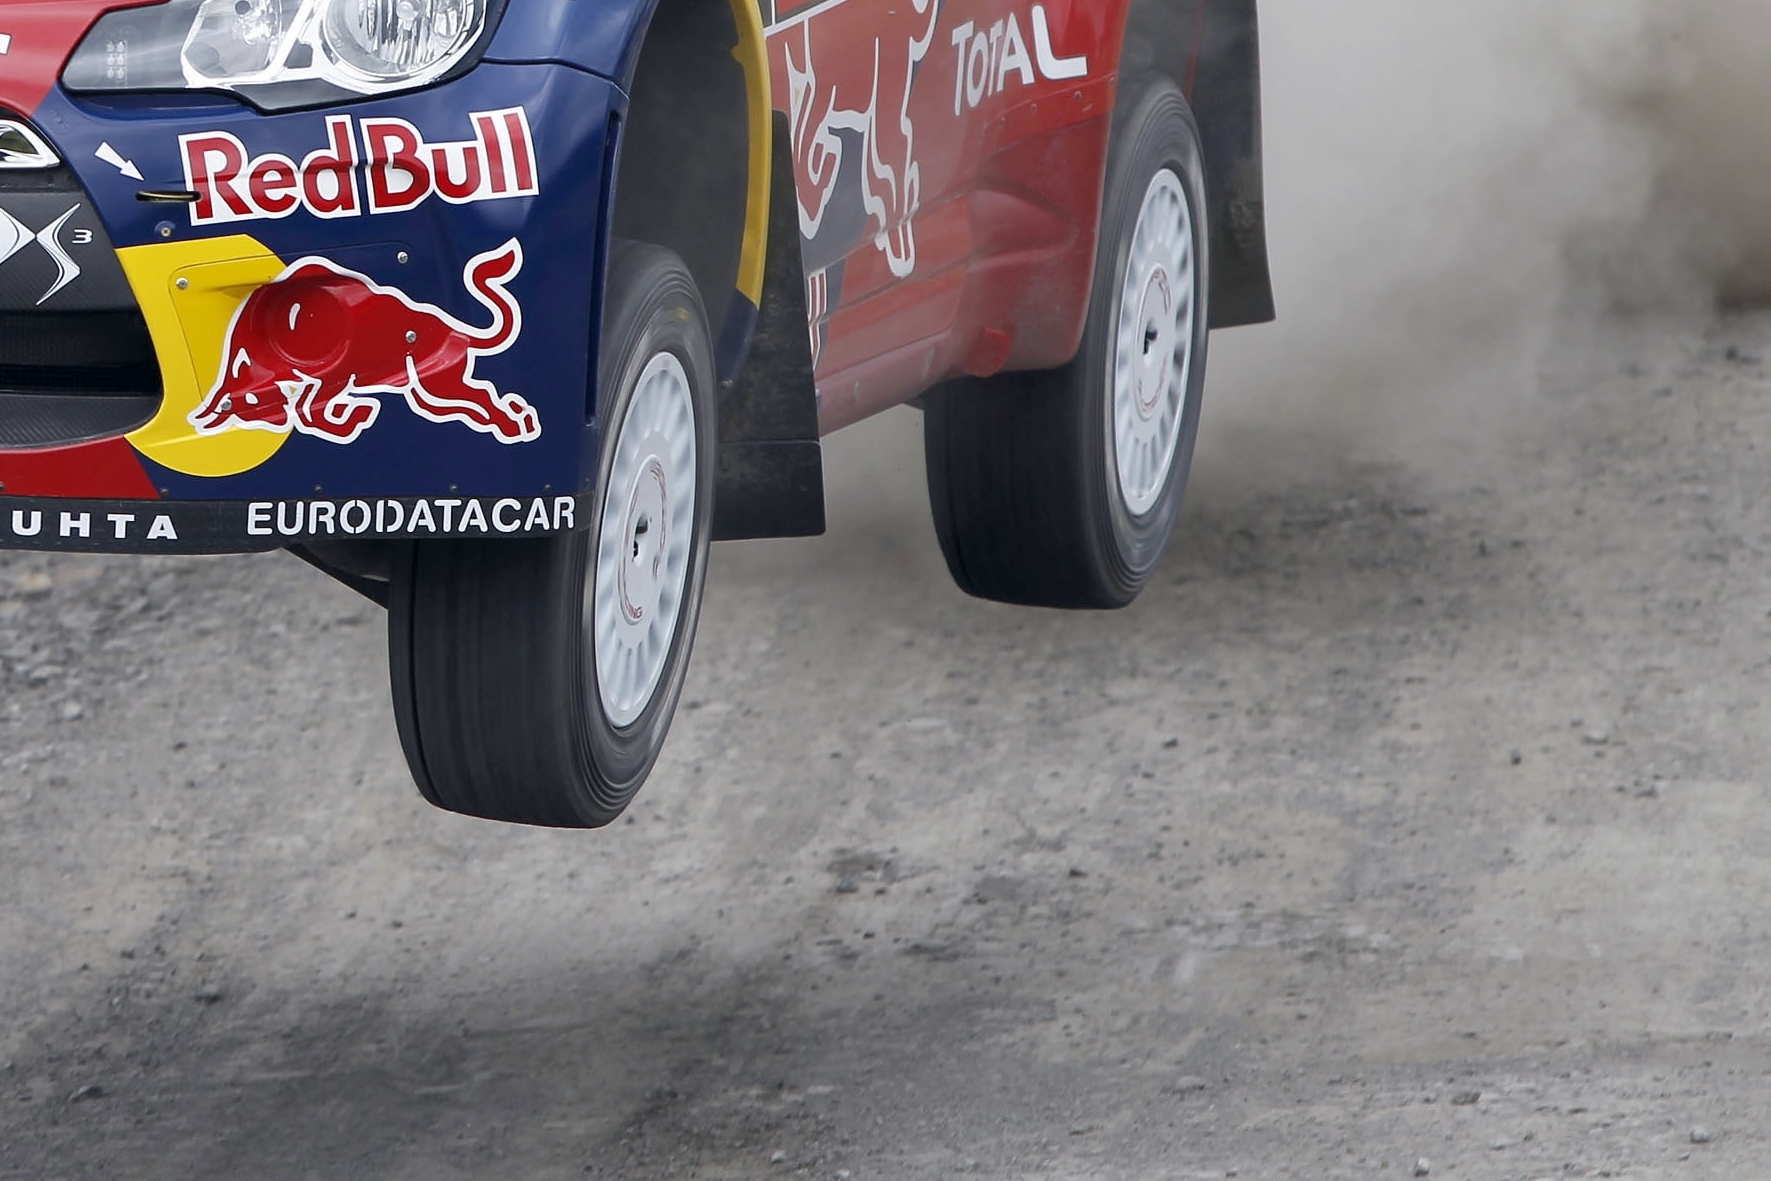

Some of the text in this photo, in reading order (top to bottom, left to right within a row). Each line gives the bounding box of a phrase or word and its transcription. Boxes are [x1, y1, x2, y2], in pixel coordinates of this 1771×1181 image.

[950, 3, 1088, 117] TOTAL
[178, 105, 540, 226] Red Bull
[247, 495, 576, 537] EURODATACAR
